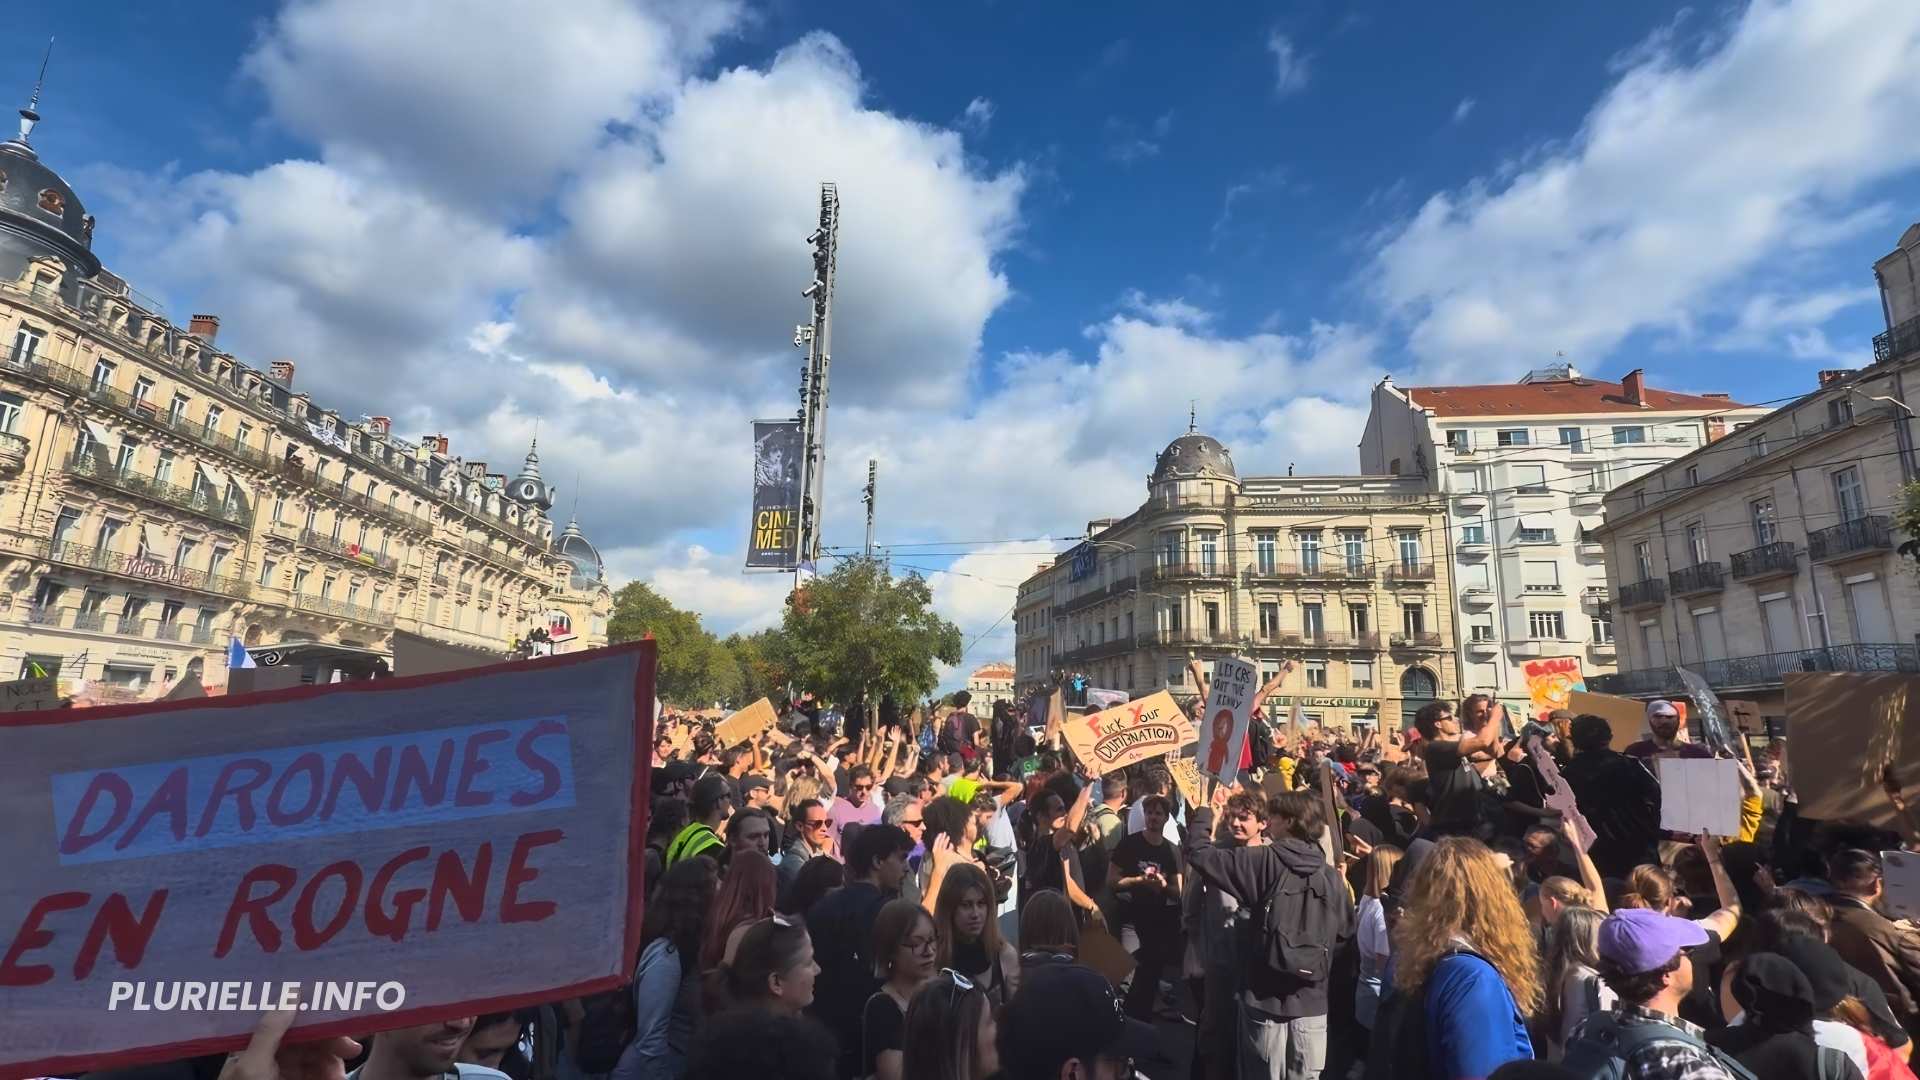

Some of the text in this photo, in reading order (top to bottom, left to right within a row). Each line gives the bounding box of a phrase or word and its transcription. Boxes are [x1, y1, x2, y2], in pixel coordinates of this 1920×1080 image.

[756, 529, 796, 549] MED
[60, 720, 567, 855] DARONNES
[1, 829, 565, 987] EN ROGNE
